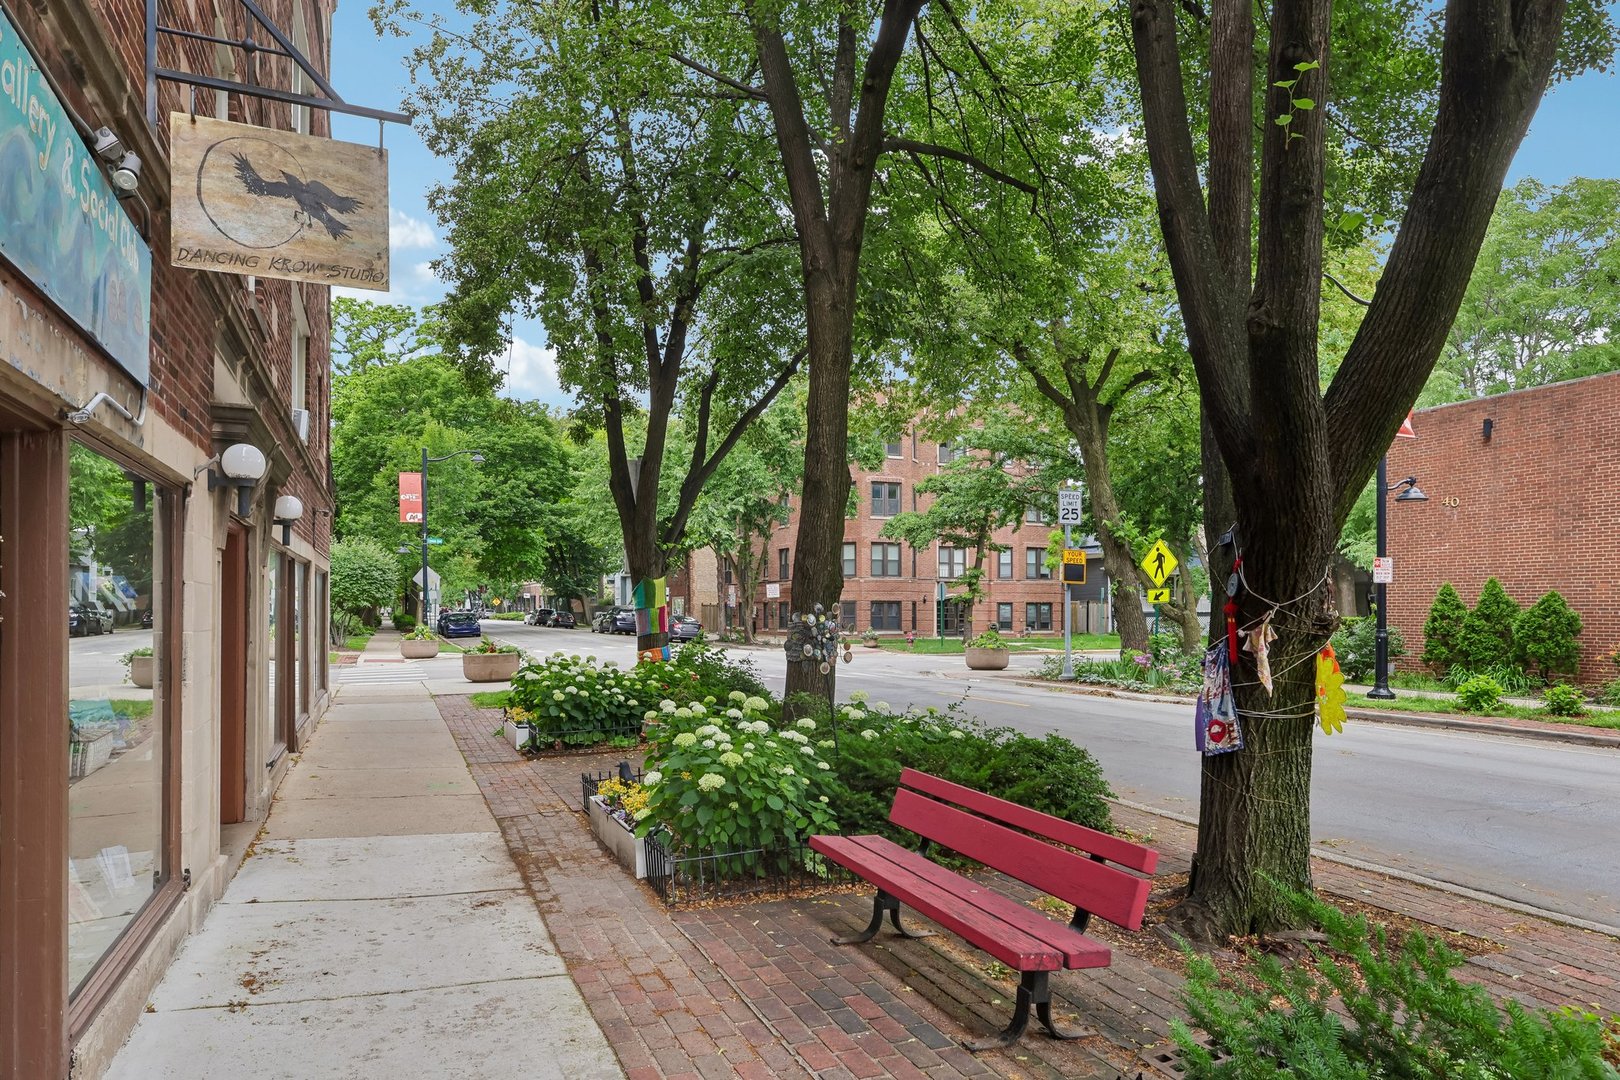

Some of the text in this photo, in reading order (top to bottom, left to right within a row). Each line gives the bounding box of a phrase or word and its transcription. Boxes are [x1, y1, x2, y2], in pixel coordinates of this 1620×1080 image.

[0, 31, 139, 273] allery & Social Club
[177, 247, 260, 268] DANCING
[268, 256, 320, 274] KROW
[1442, 496, 1460, 507] 40
[1061, 508, 1079, 520] 25
